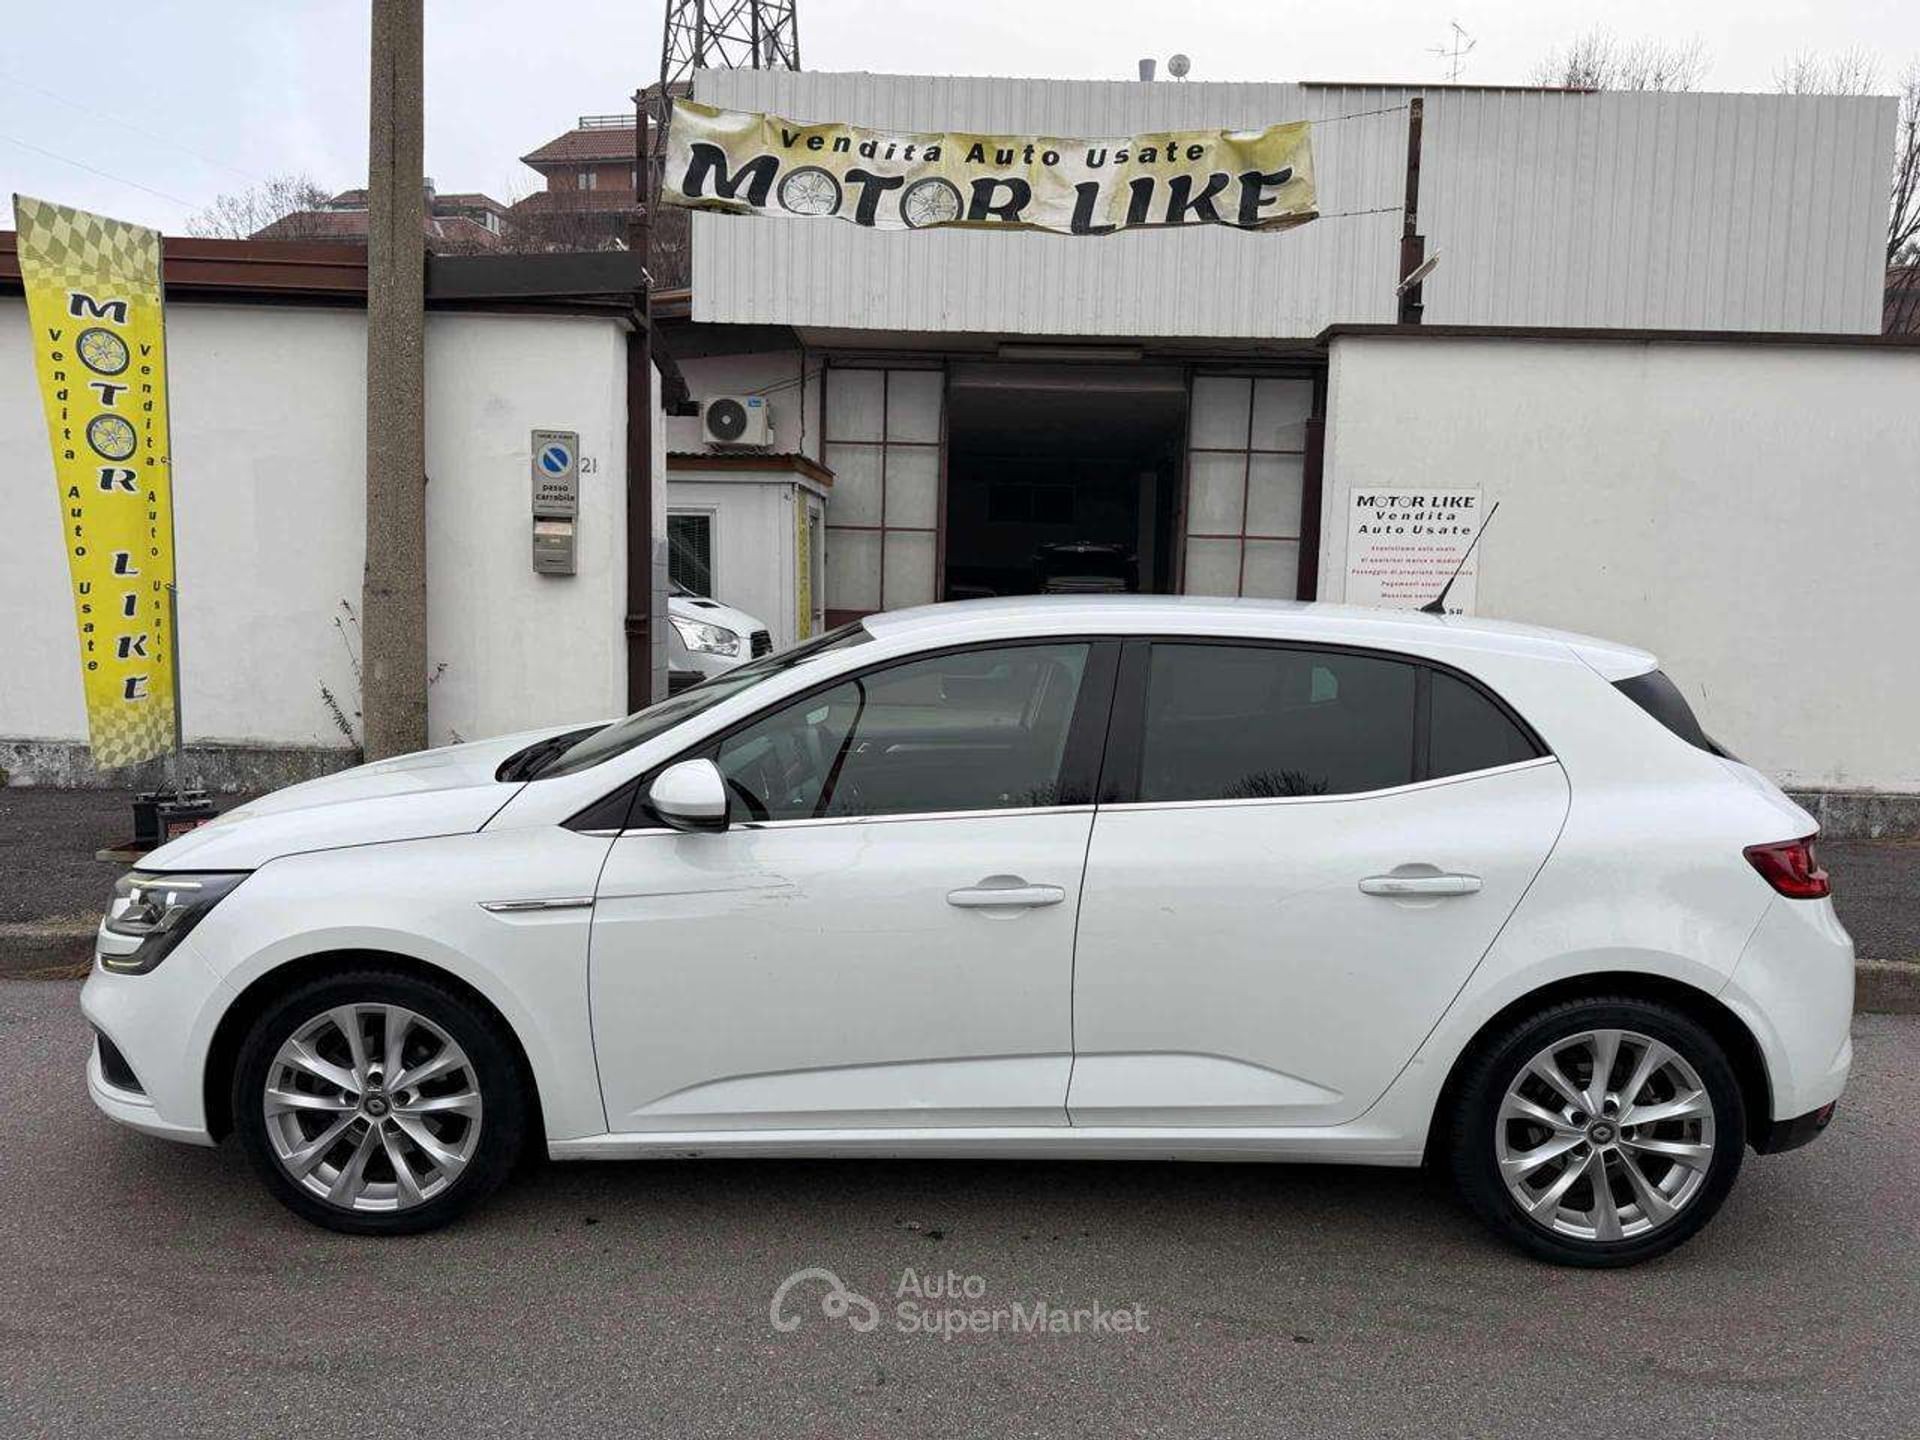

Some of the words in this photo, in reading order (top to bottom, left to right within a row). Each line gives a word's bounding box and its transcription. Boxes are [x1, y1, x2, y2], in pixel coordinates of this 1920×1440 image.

[782, 128, 942, 161] Vendita
[965, 143, 1060, 166] Auto
[1086, 141, 1204, 168] Usate
[682, 142, 1032, 228] MOTOR
[1070, 166, 1293, 235] LIKE
[140, 344, 155, 467] Vendita
[581, 457, 597, 473] 21
[48, 328, 75, 460] Vendita
[68, 486, 87, 557] Auto
[79, 582, 98, 671] Usate
[69, 292, 136, 492] MOTOR
[114, 552, 148, 700] LIKE
[1357, 495, 1425, 508] MOTOR
[1431, 496, 1475, 508] LIKE
[1376, 511, 1456, 521] Vendita
[1358, 525, 1404, 534] Auto
[1412, 525, 1471, 535] Usate
